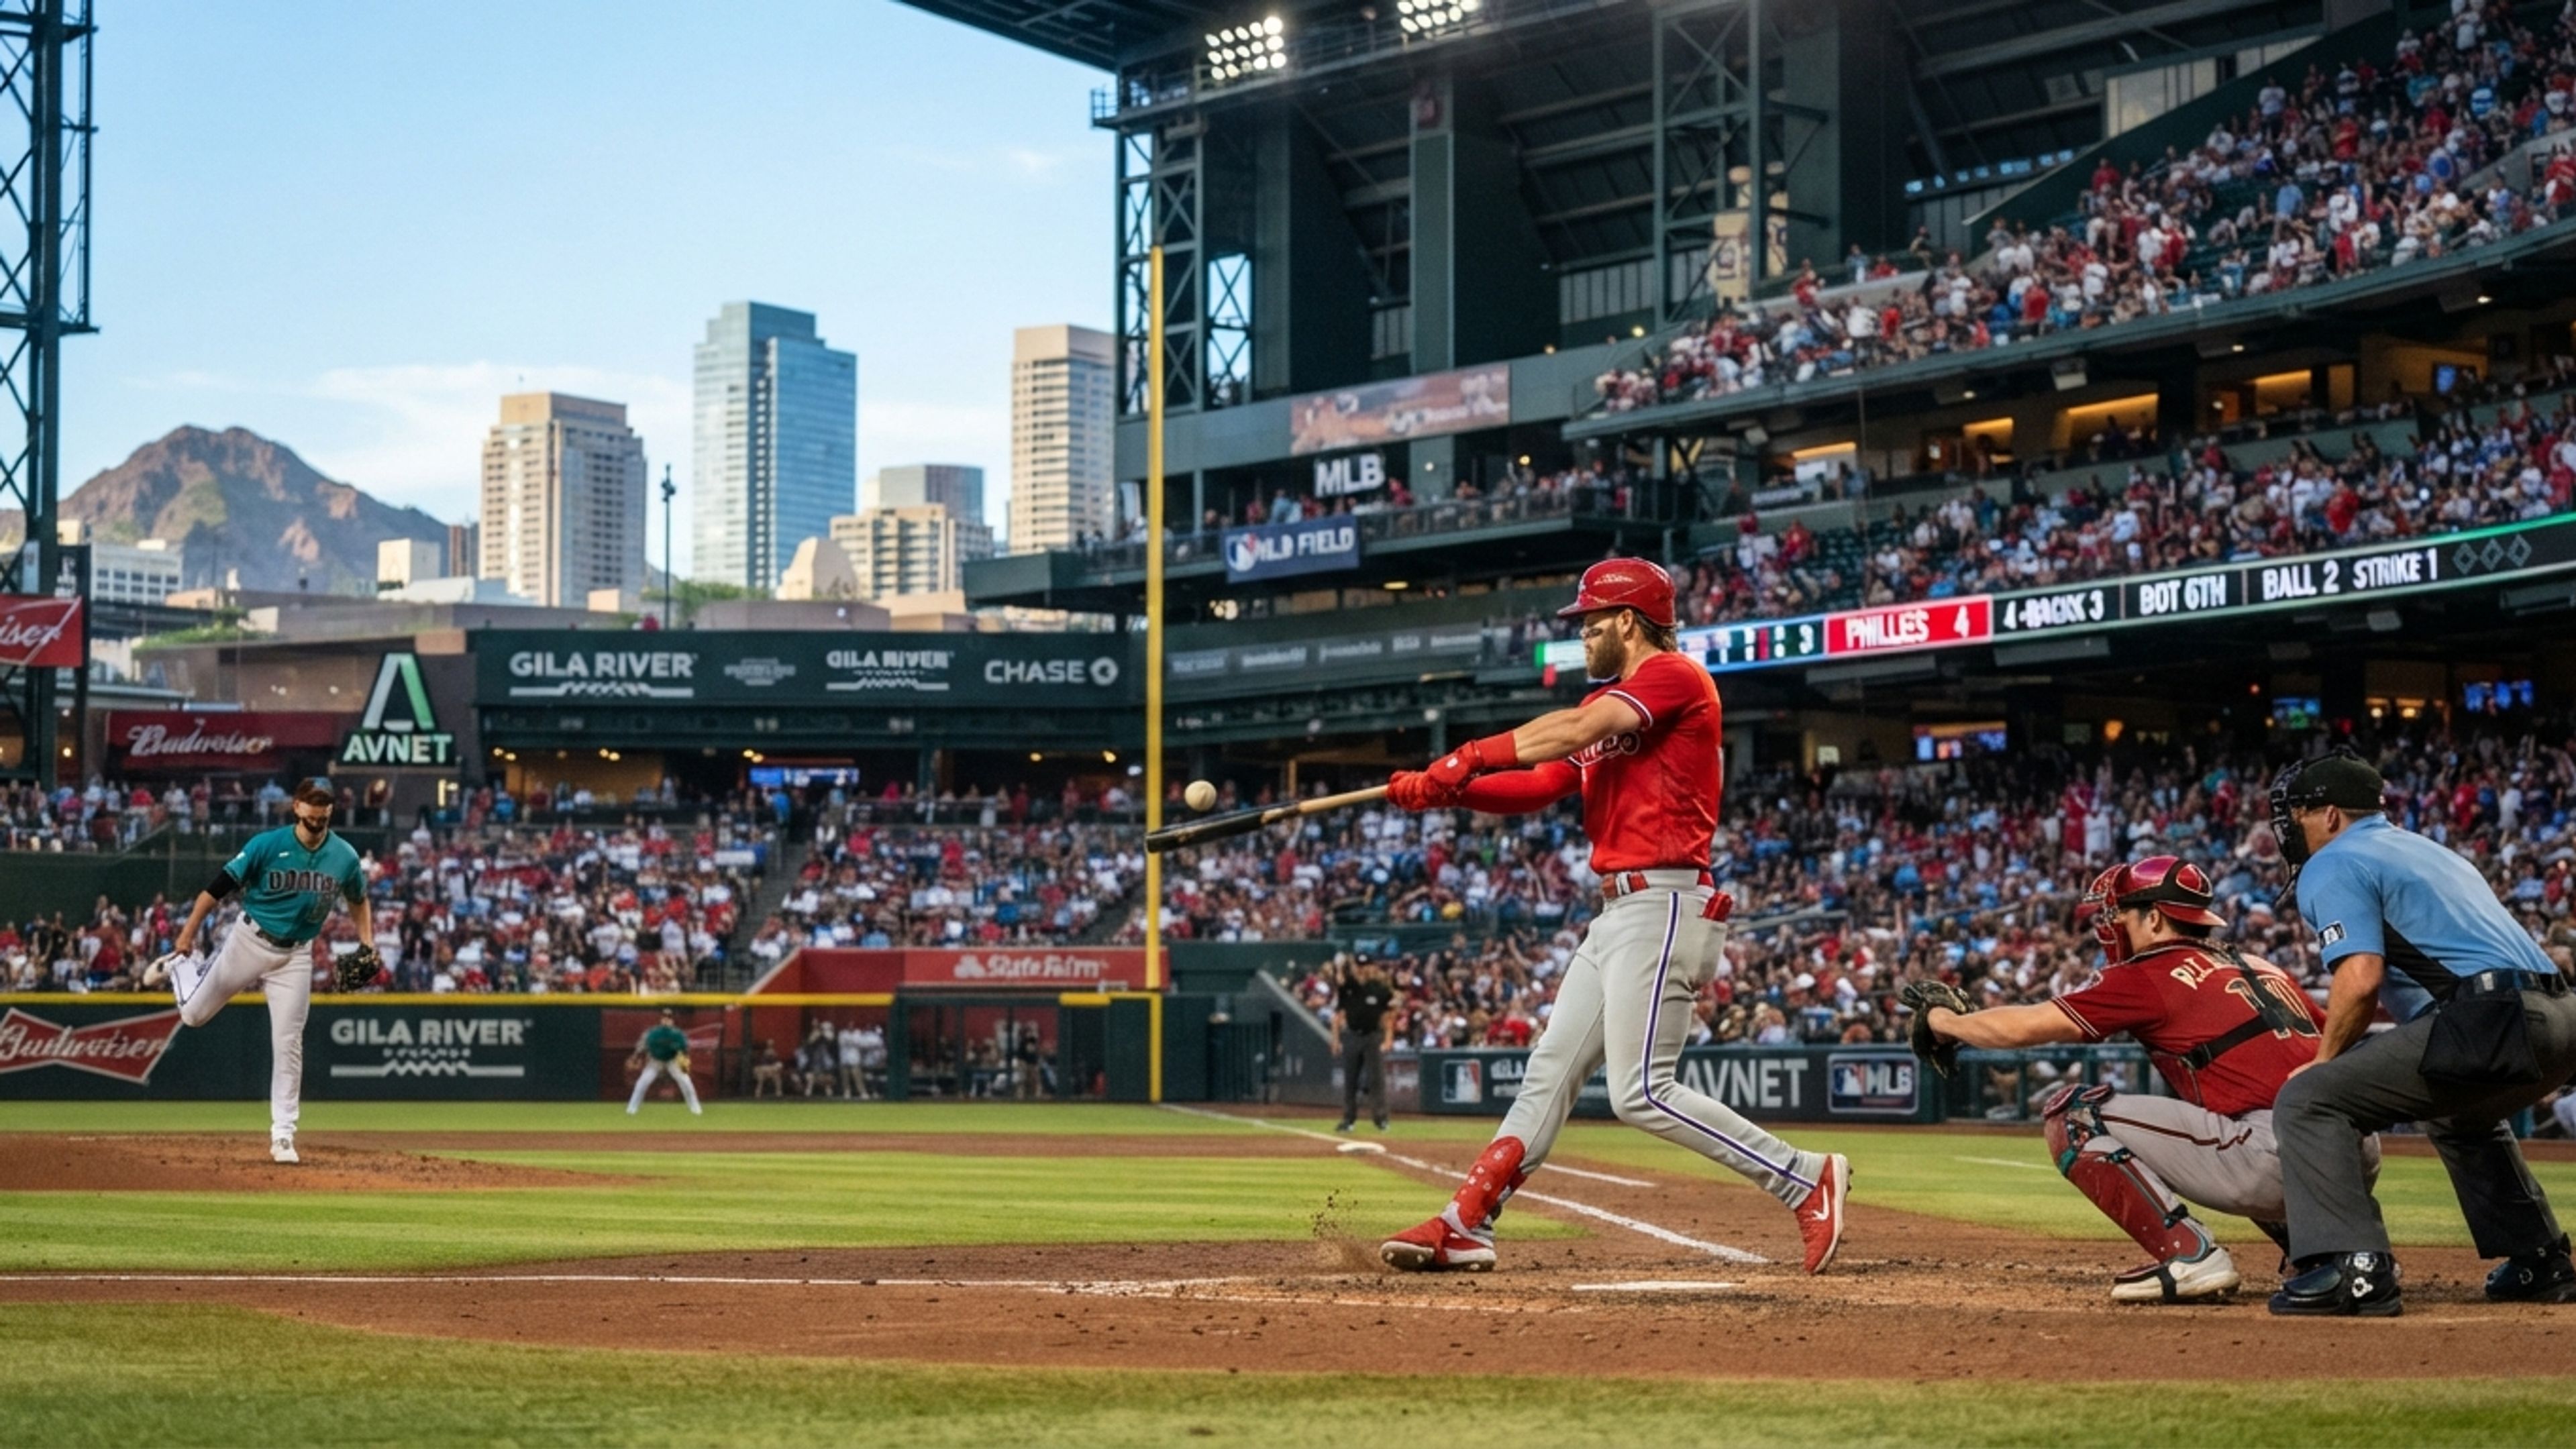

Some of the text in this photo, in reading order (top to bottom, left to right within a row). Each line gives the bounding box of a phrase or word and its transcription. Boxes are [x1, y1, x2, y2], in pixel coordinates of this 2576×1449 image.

[1315, 453, 1386, 498] MLB
[2261, 547, 2438, 601] BALL 2 STRIKE 1
[2139, 574, 2227, 616] BOT 6TH
[509, 651, 589, 678] GILA
[594, 651, 694, 678] RIVER
[984, 659, 1086, 684] CHASE
[342, 733, 453, 763] AVNET
[330, 1018, 525, 1045] GILA RIVER
[1682, 1058, 1809, 1108] AVNET
[1863, 1062, 1912, 1096] MLB
